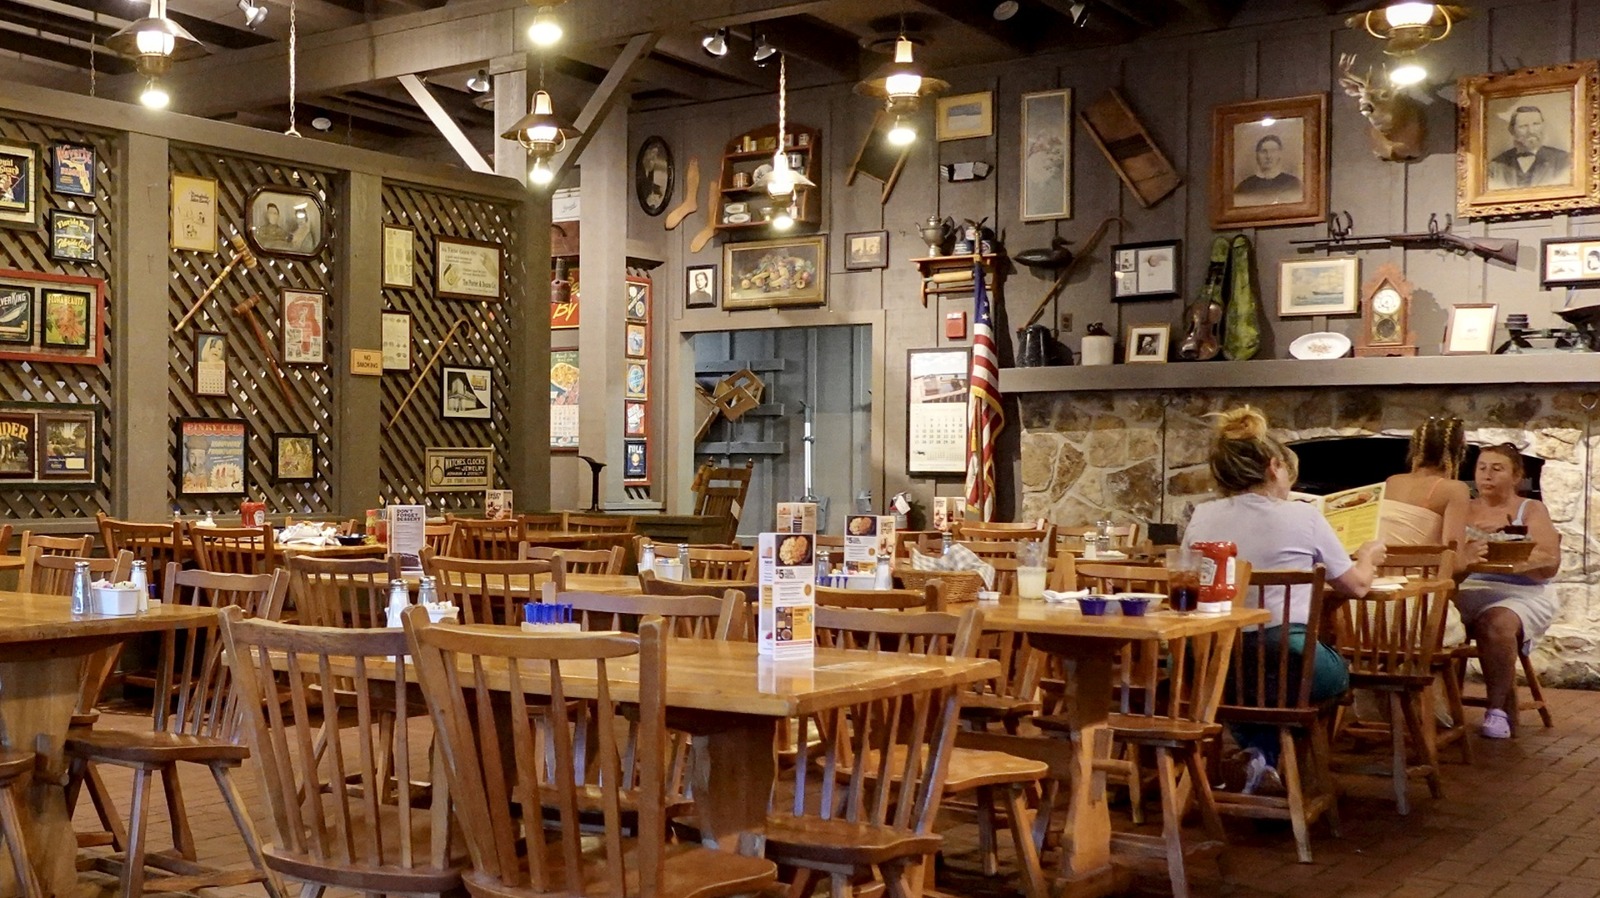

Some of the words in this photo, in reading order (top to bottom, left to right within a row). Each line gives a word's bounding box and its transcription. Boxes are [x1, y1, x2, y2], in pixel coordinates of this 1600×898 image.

[57, 217, 79, 229] Florida
[79, 219, 90, 233] Boy
[56, 237, 78, 249] Florida
[356, 361, 379, 369] SMOKING
[187, 423, 216, 431] PINKY
[220, 424, 238, 432] LEE
